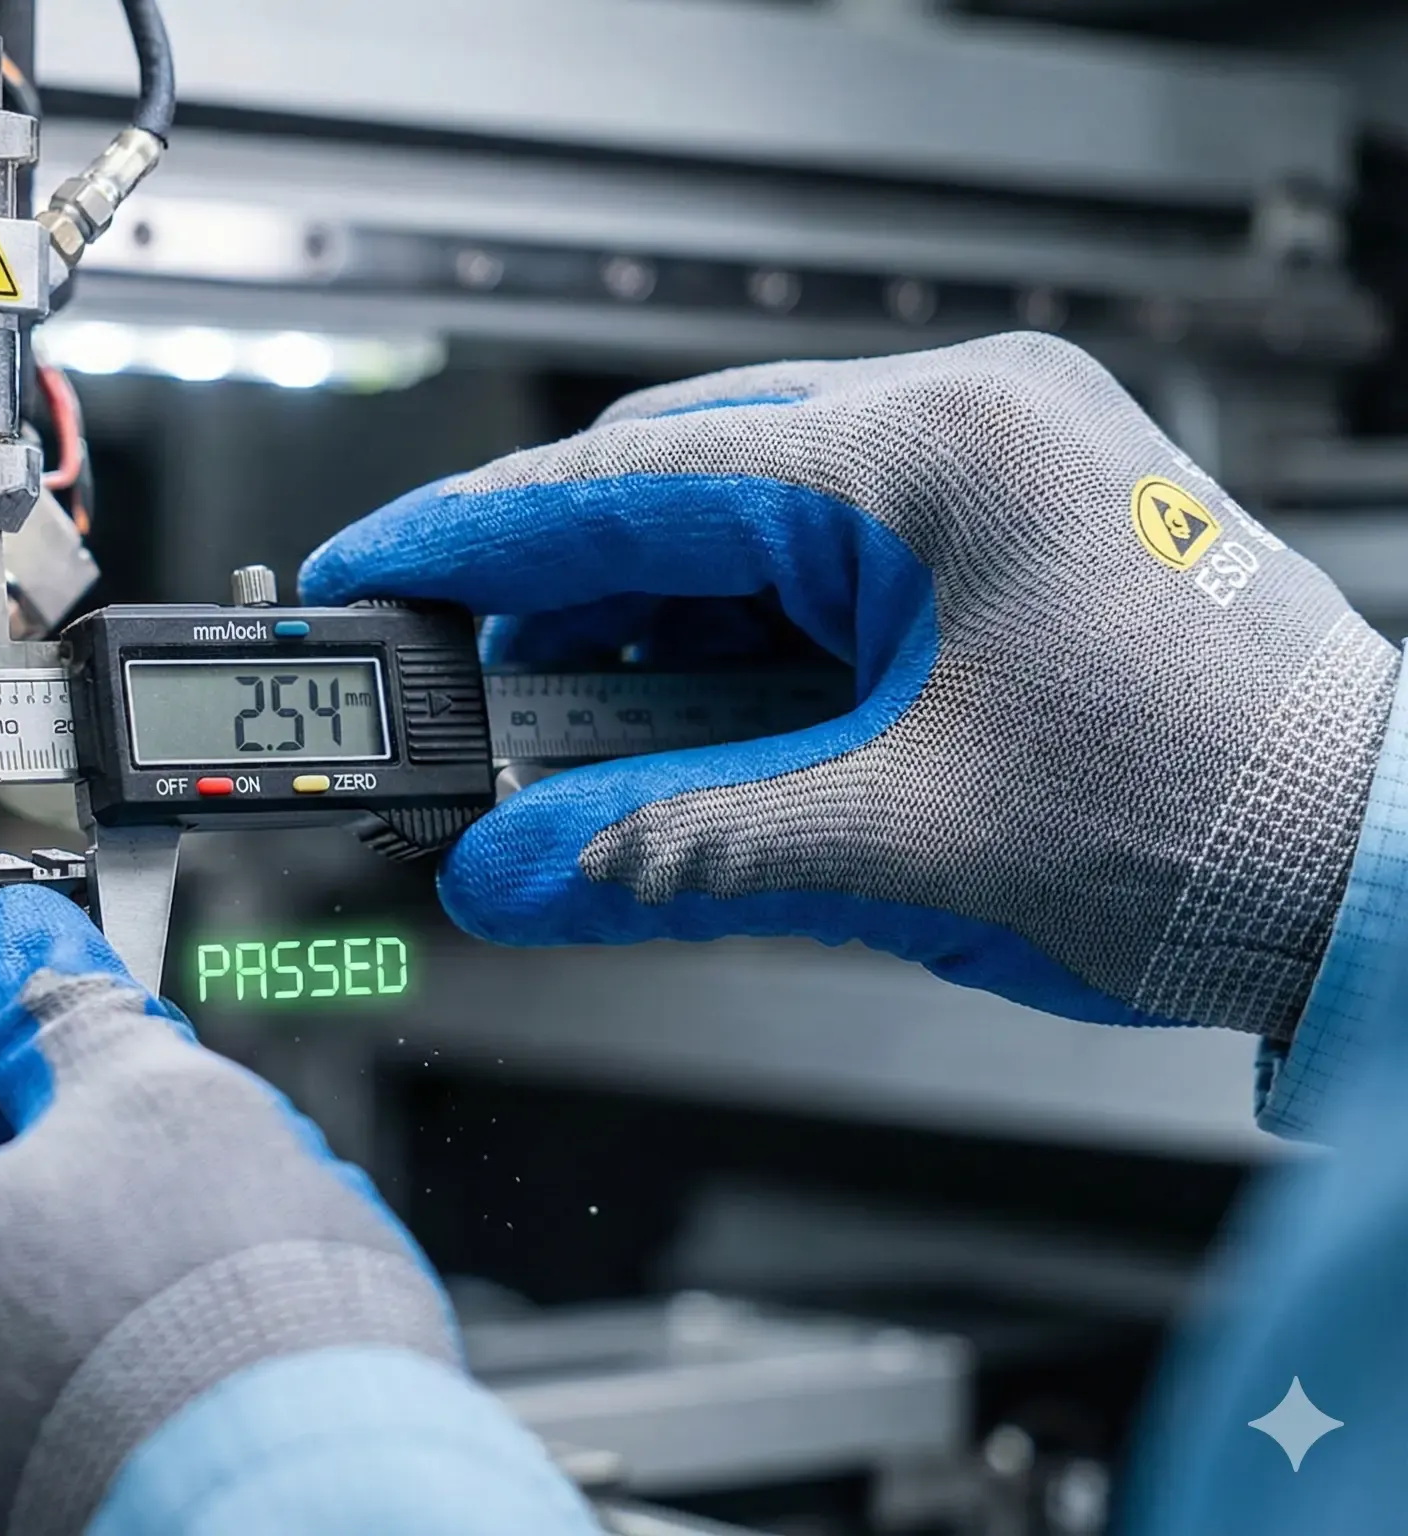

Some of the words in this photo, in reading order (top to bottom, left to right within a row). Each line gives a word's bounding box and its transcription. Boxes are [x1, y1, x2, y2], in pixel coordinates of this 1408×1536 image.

[1194, 541, 1260, 607] ESD
[234, 675, 342, 752] 2.54
[344, 692, 372, 708] mm
[156, 778, 189, 796] OFF
[235, 776, 261, 793] ON
